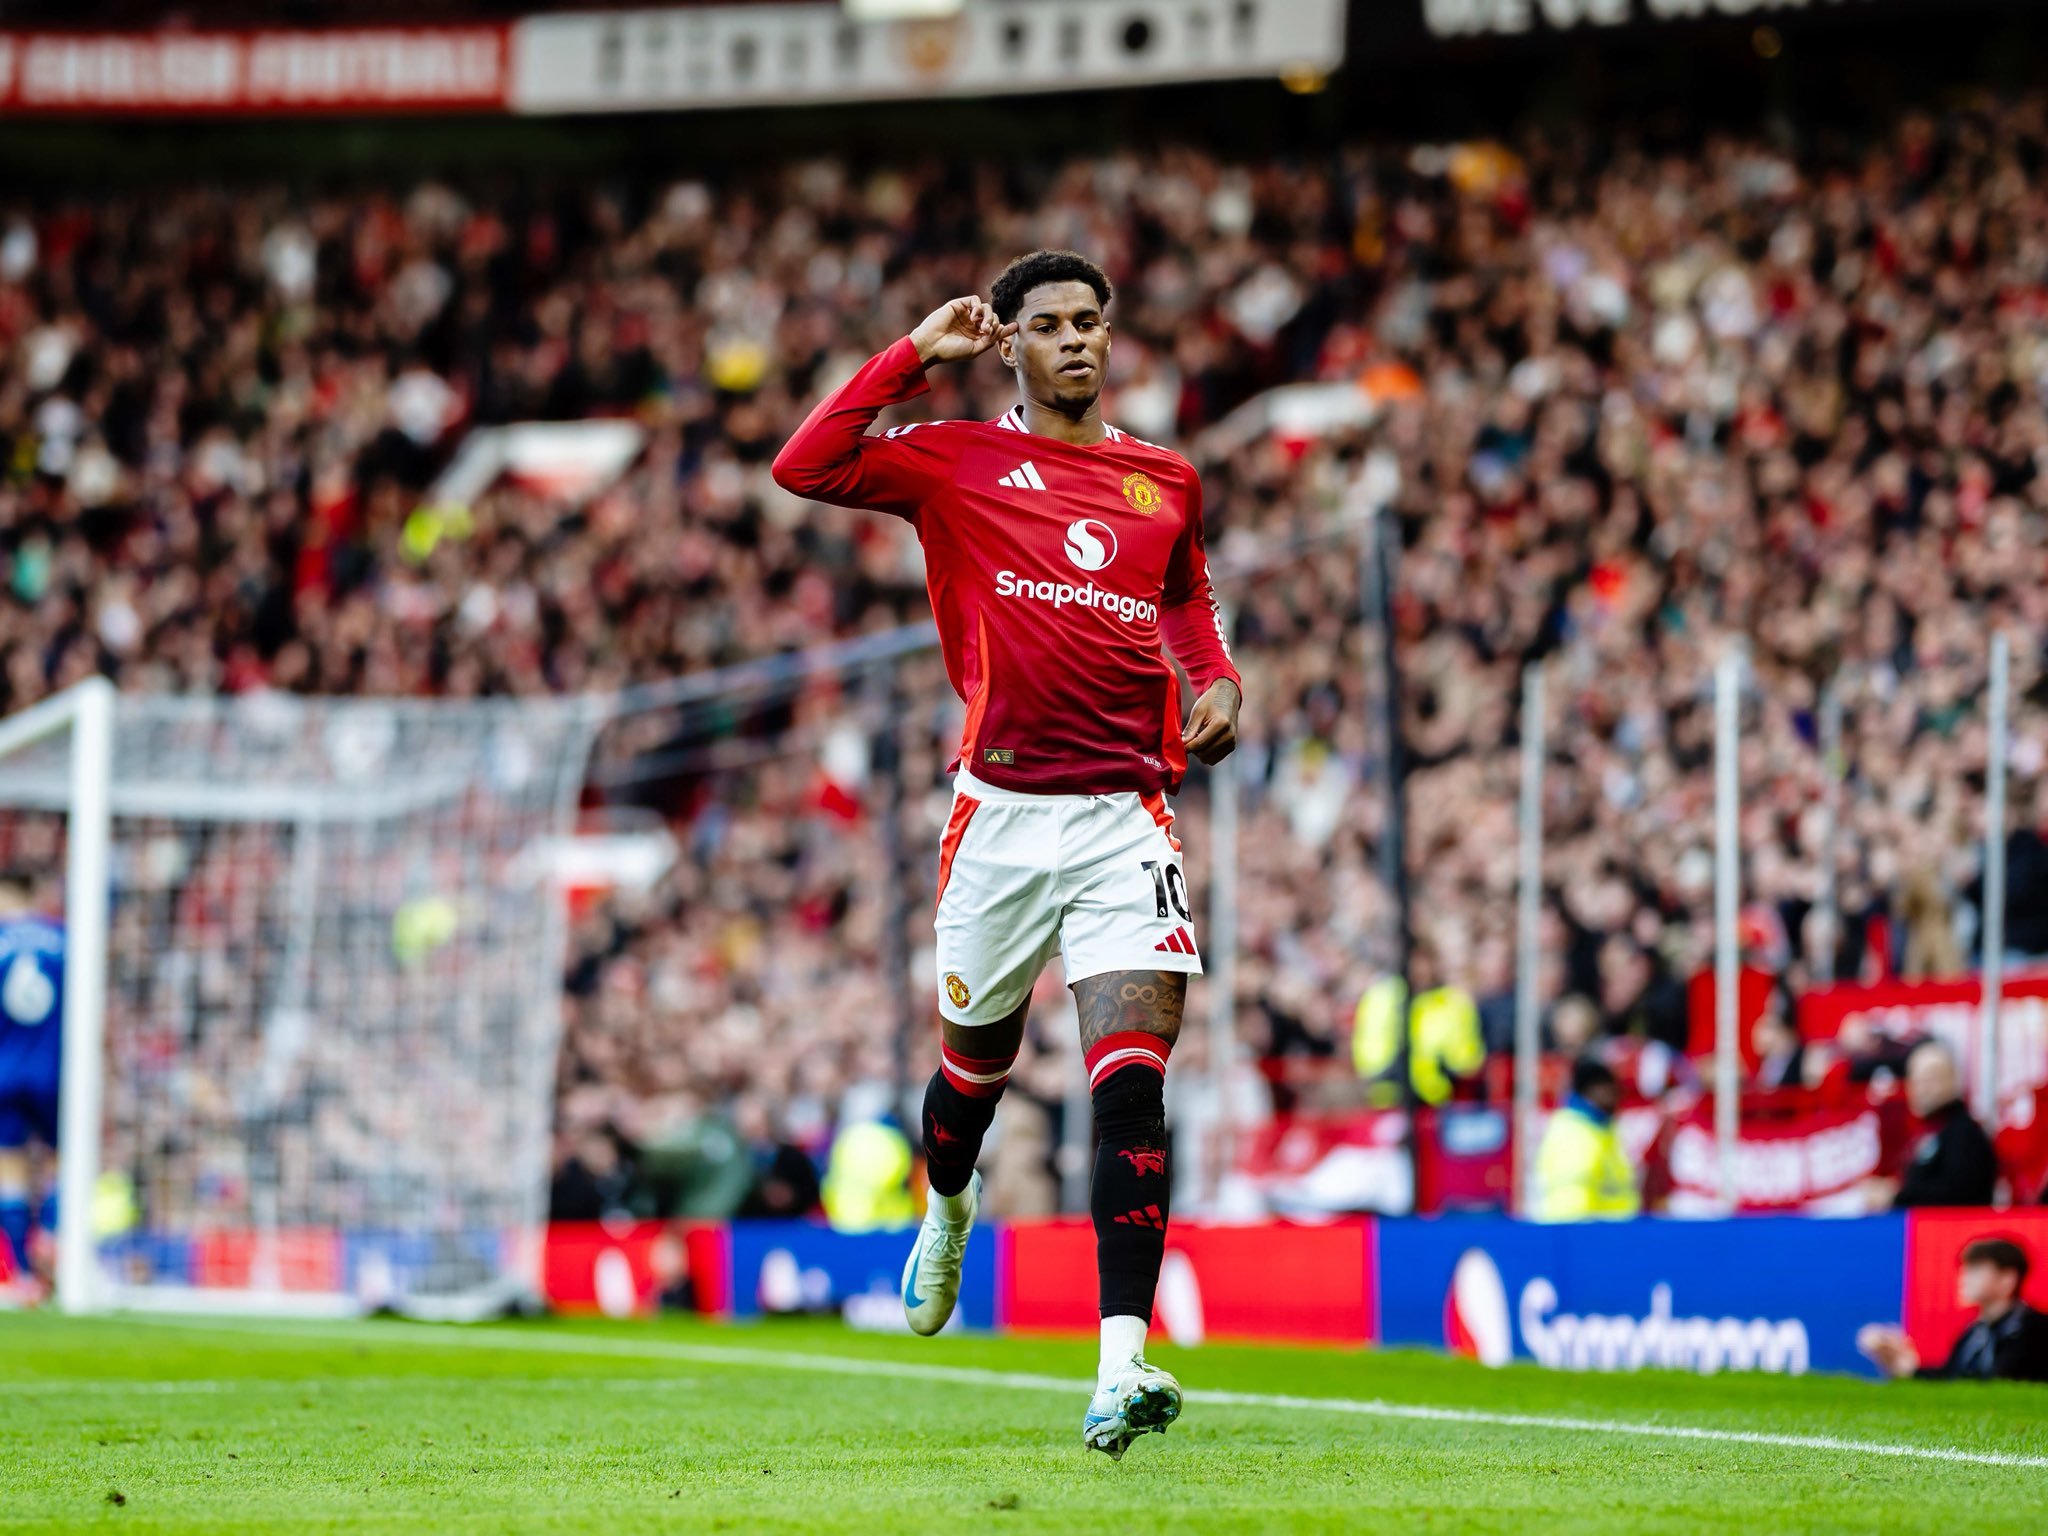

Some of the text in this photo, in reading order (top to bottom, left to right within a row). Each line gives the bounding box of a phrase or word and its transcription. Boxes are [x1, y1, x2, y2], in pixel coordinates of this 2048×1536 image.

[1133, 502, 1157, 512] UNITED
[995, 570, 1158, 624] Snapdragon
[1140, 860, 1193, 923] 10
[2, 953, 56, 1026] 6
